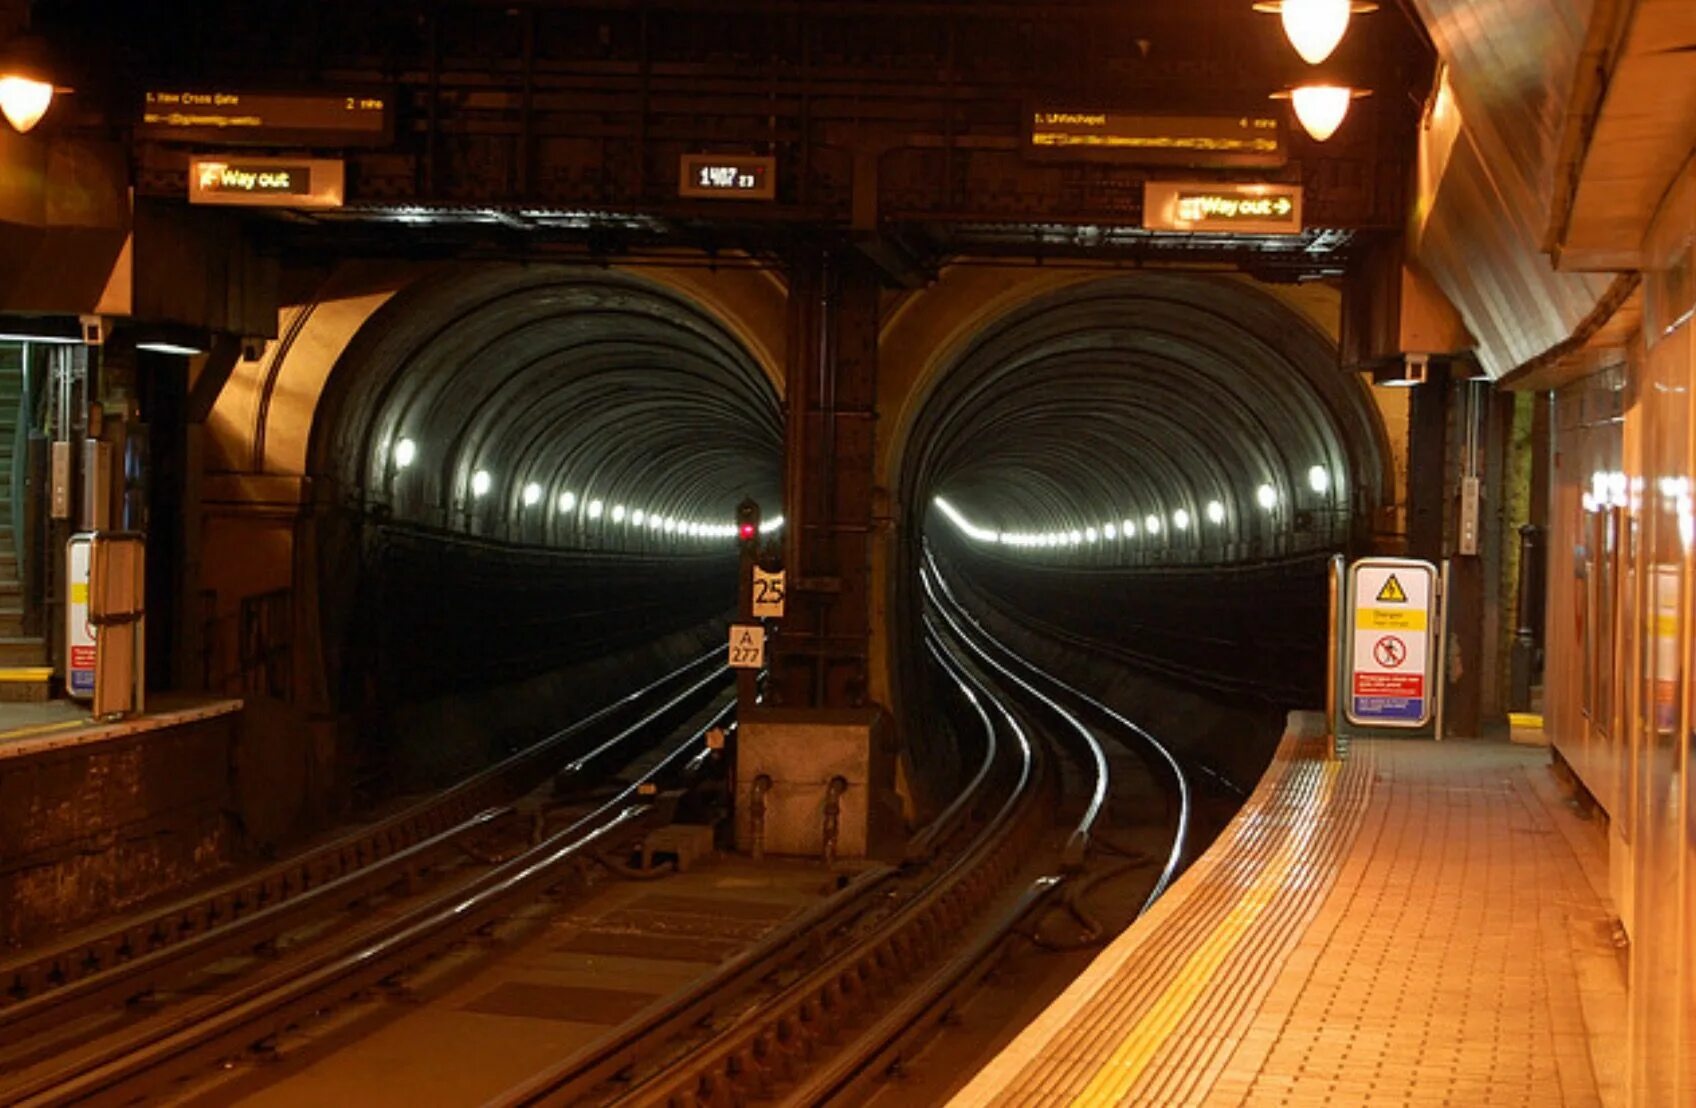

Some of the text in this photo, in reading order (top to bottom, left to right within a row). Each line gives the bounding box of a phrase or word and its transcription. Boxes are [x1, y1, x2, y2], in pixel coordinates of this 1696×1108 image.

[182, 92, 212, 104] Cross
[214, 93, 239, 106] Gate
[346, 97, 354, 109] 2
[220, 169, 291, 190] Way out
[1201, 196, 1272, 218] Way out
[754, 578, 785, 604] 25
[740, 630, 754, 646] A
[732, 646, 760, 663] 277
